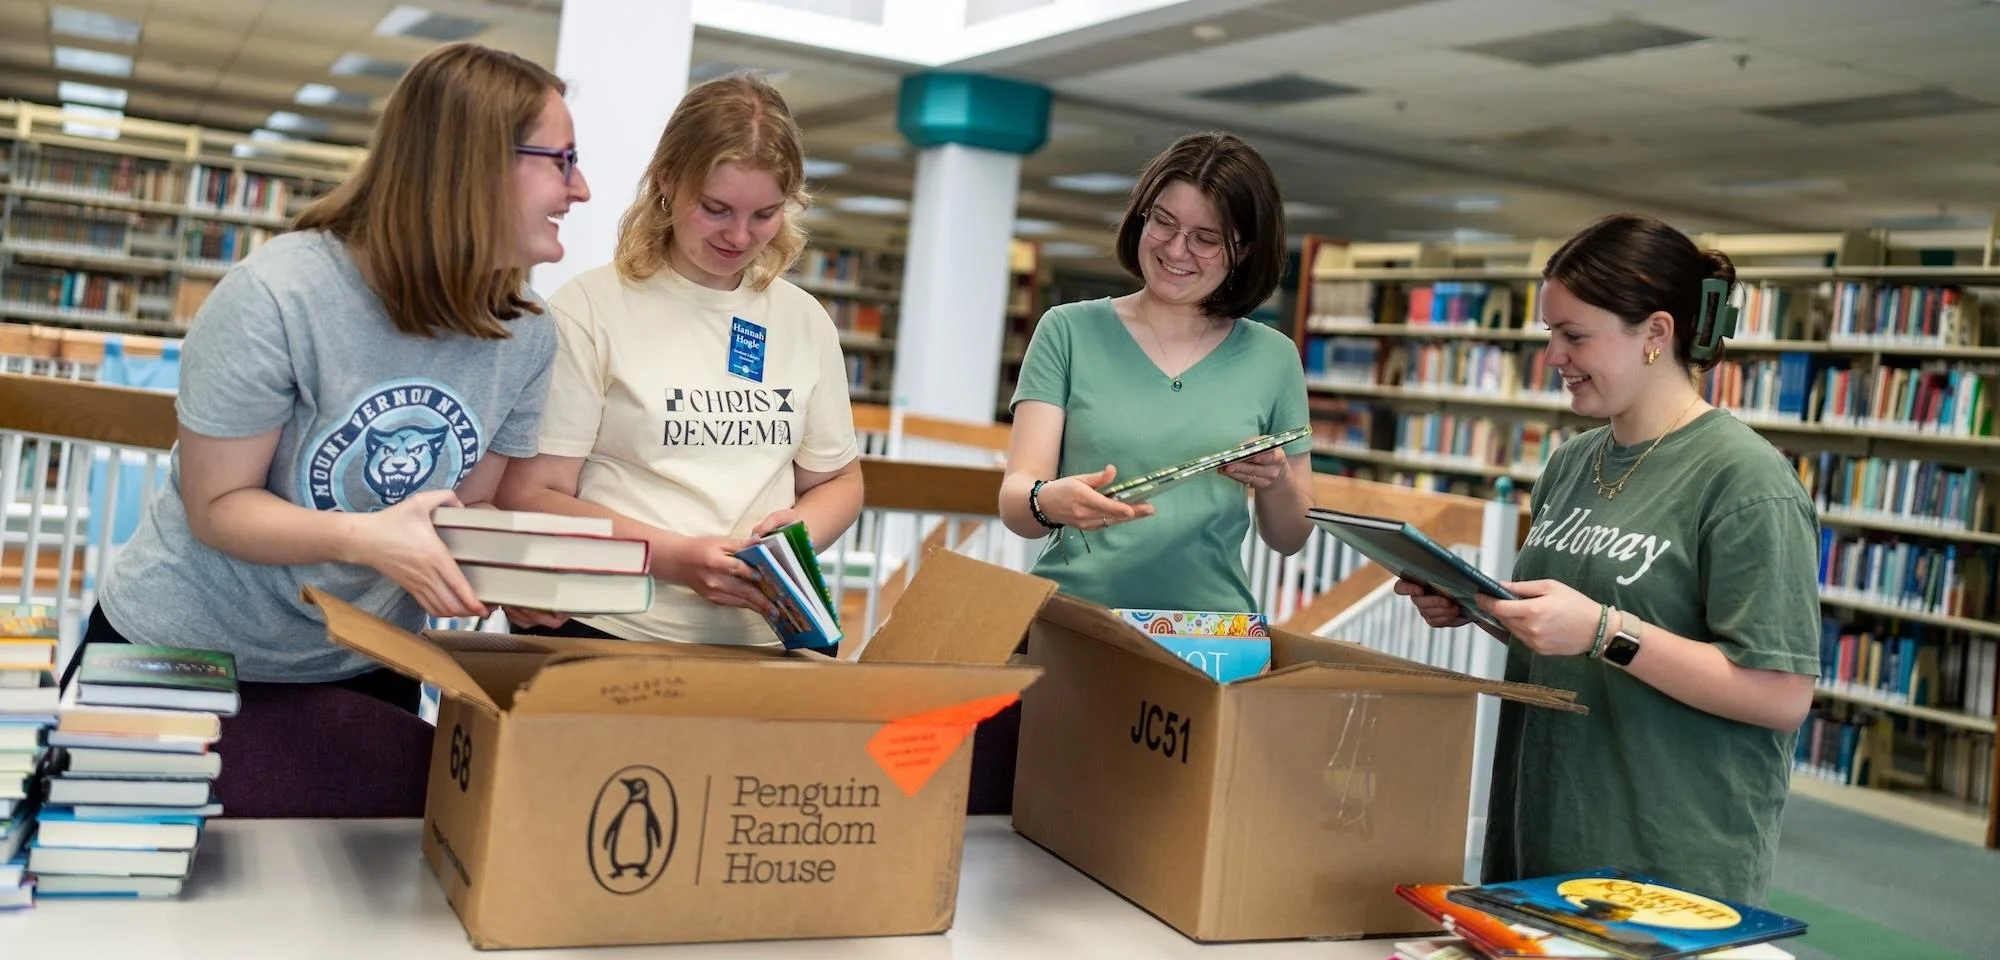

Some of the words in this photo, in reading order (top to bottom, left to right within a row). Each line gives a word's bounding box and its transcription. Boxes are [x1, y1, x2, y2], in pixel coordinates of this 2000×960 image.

[733, 323, 765, 341] Hannah
[736, 334, 760, 349] Hogle
[690, 388, 771, 414] CHRIS
[313, 431, 350, 497] MOUNT
[351, 387, 432, 430] VERNON
[435, 397, 478, 488] NAZARE
[662, 419, 792, 446] RENZEMA
[1177, 650, 1229, 681] OT
[1130, 700, 1190, 764] JC51
[450, 723, 472, 793] 68
[731, 775, 881, 816] Penguin
[727, 813, 877, 846] Random
[721, 852, 836, 884] House
[1594, 880, 1732, 920] KNIGHT
